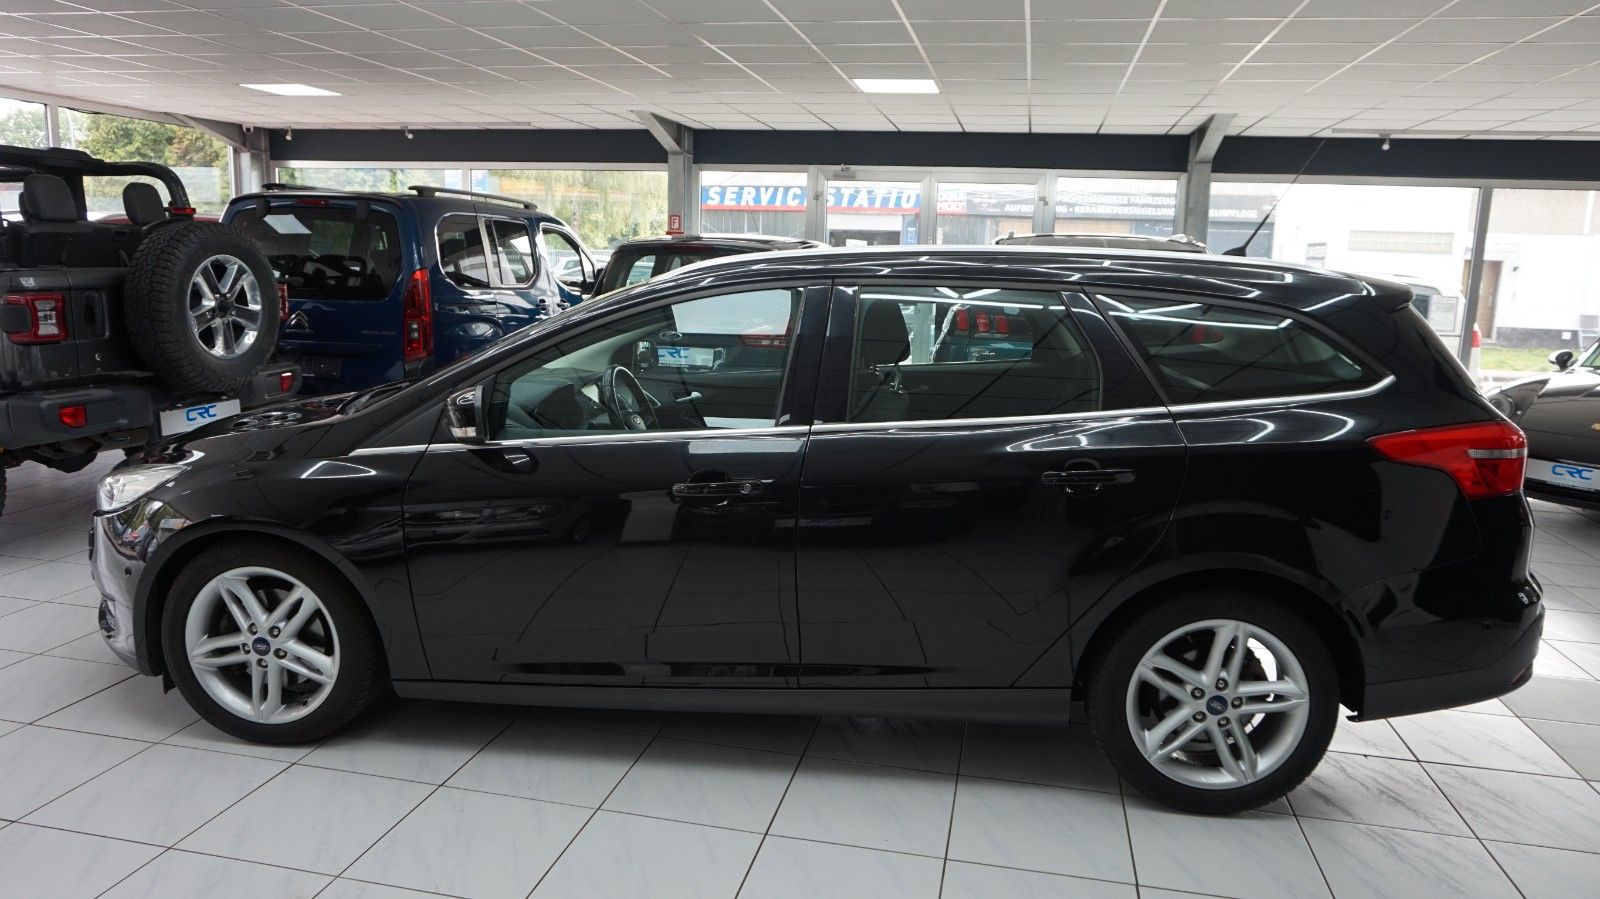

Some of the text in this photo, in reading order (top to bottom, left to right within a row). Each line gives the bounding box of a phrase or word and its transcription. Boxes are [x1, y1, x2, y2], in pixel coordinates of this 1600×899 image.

[706, 186, 807, 206] SERVIC
[827, 186, 918, 208] STATIO
[186, 404, 217, 421] CRC
[1552, 464, 1594, 480] CRC
